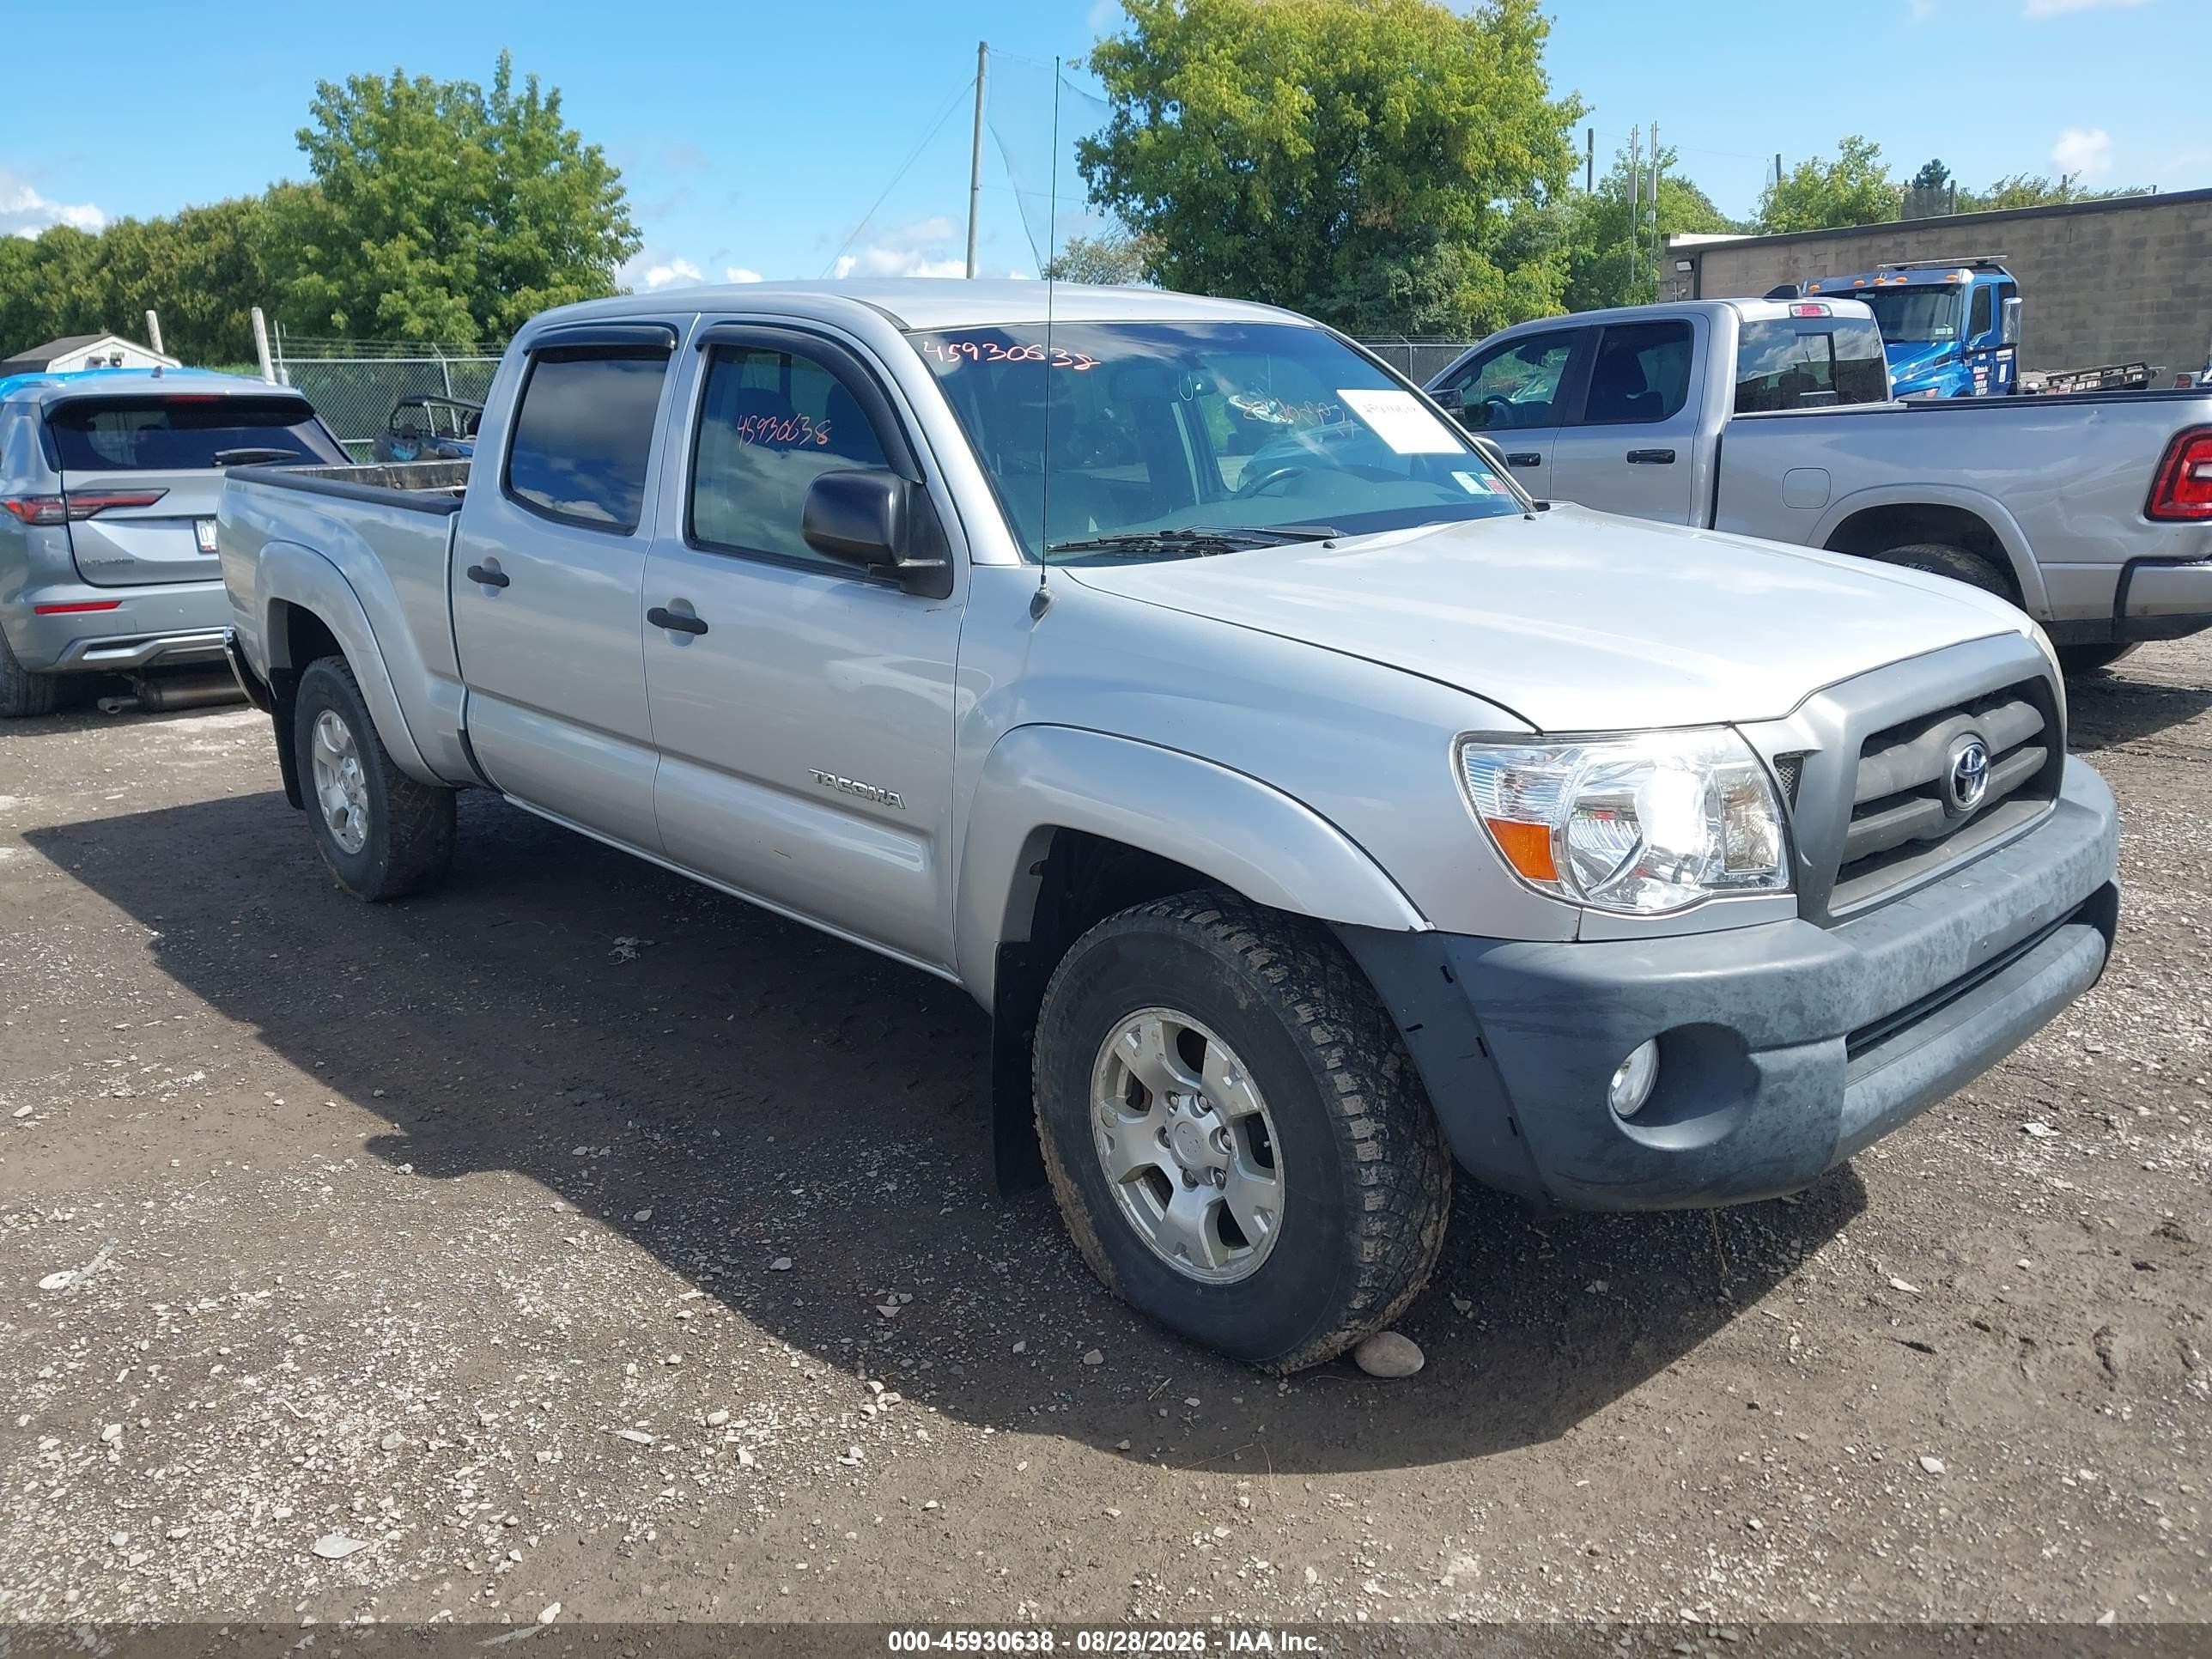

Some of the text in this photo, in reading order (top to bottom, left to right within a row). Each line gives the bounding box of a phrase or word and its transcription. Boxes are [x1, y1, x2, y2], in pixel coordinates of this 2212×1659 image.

[924, 341, 1101, 370] 45930638
[737, 413, 831, 450] 45930638
[808, 768, 906, 809] TACOMA
